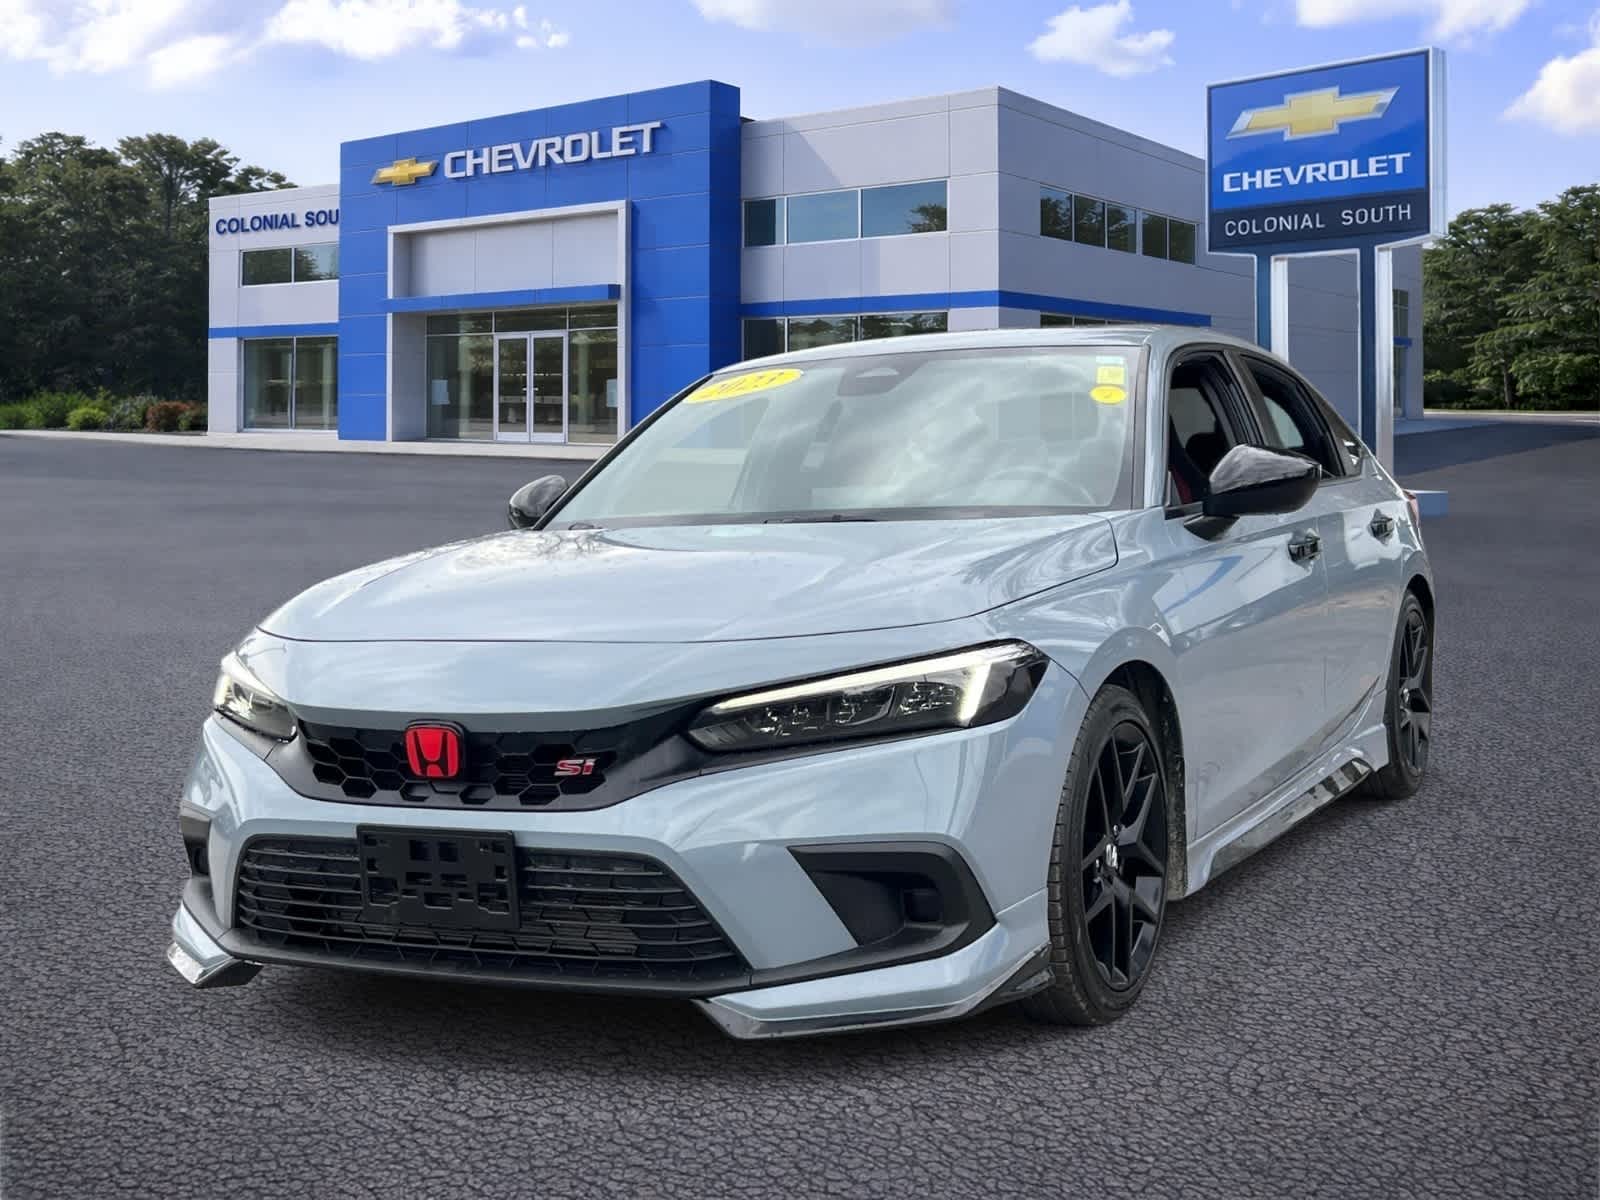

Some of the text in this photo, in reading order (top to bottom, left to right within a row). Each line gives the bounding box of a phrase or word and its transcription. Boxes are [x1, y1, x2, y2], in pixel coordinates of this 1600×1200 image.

[444, 121, 662, 179] CHEVROLET
[1223, 152, 1411, 193] CHEVROLET
[215, 212, 301, 235] COLONIAL
[1224, 203, 1411, 237] COLONIAL SOUTH
